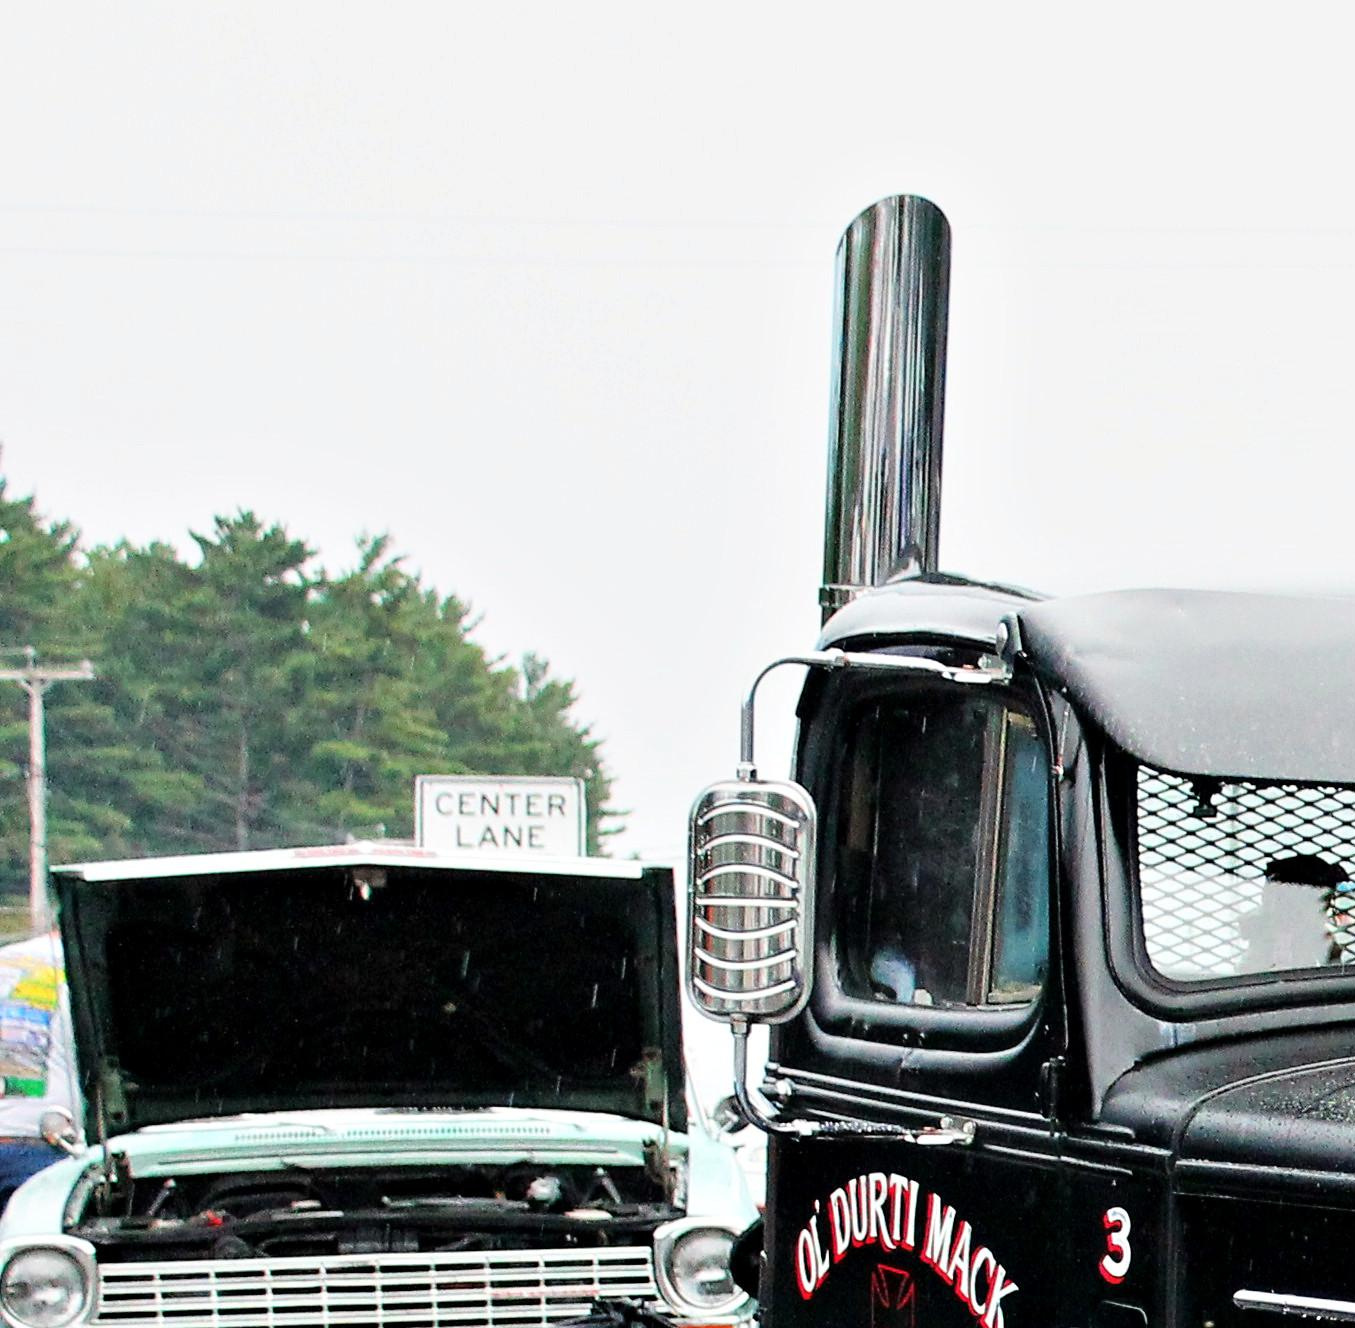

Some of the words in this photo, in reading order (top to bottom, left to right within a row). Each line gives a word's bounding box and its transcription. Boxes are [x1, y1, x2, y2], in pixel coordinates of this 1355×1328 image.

[434, 793, 567, 816] CENTER
[456, 825, 545, 848] LANE
[828, 1172, 920, 1263] DURTI
[1100, 1206, 1132, 1285] 3
